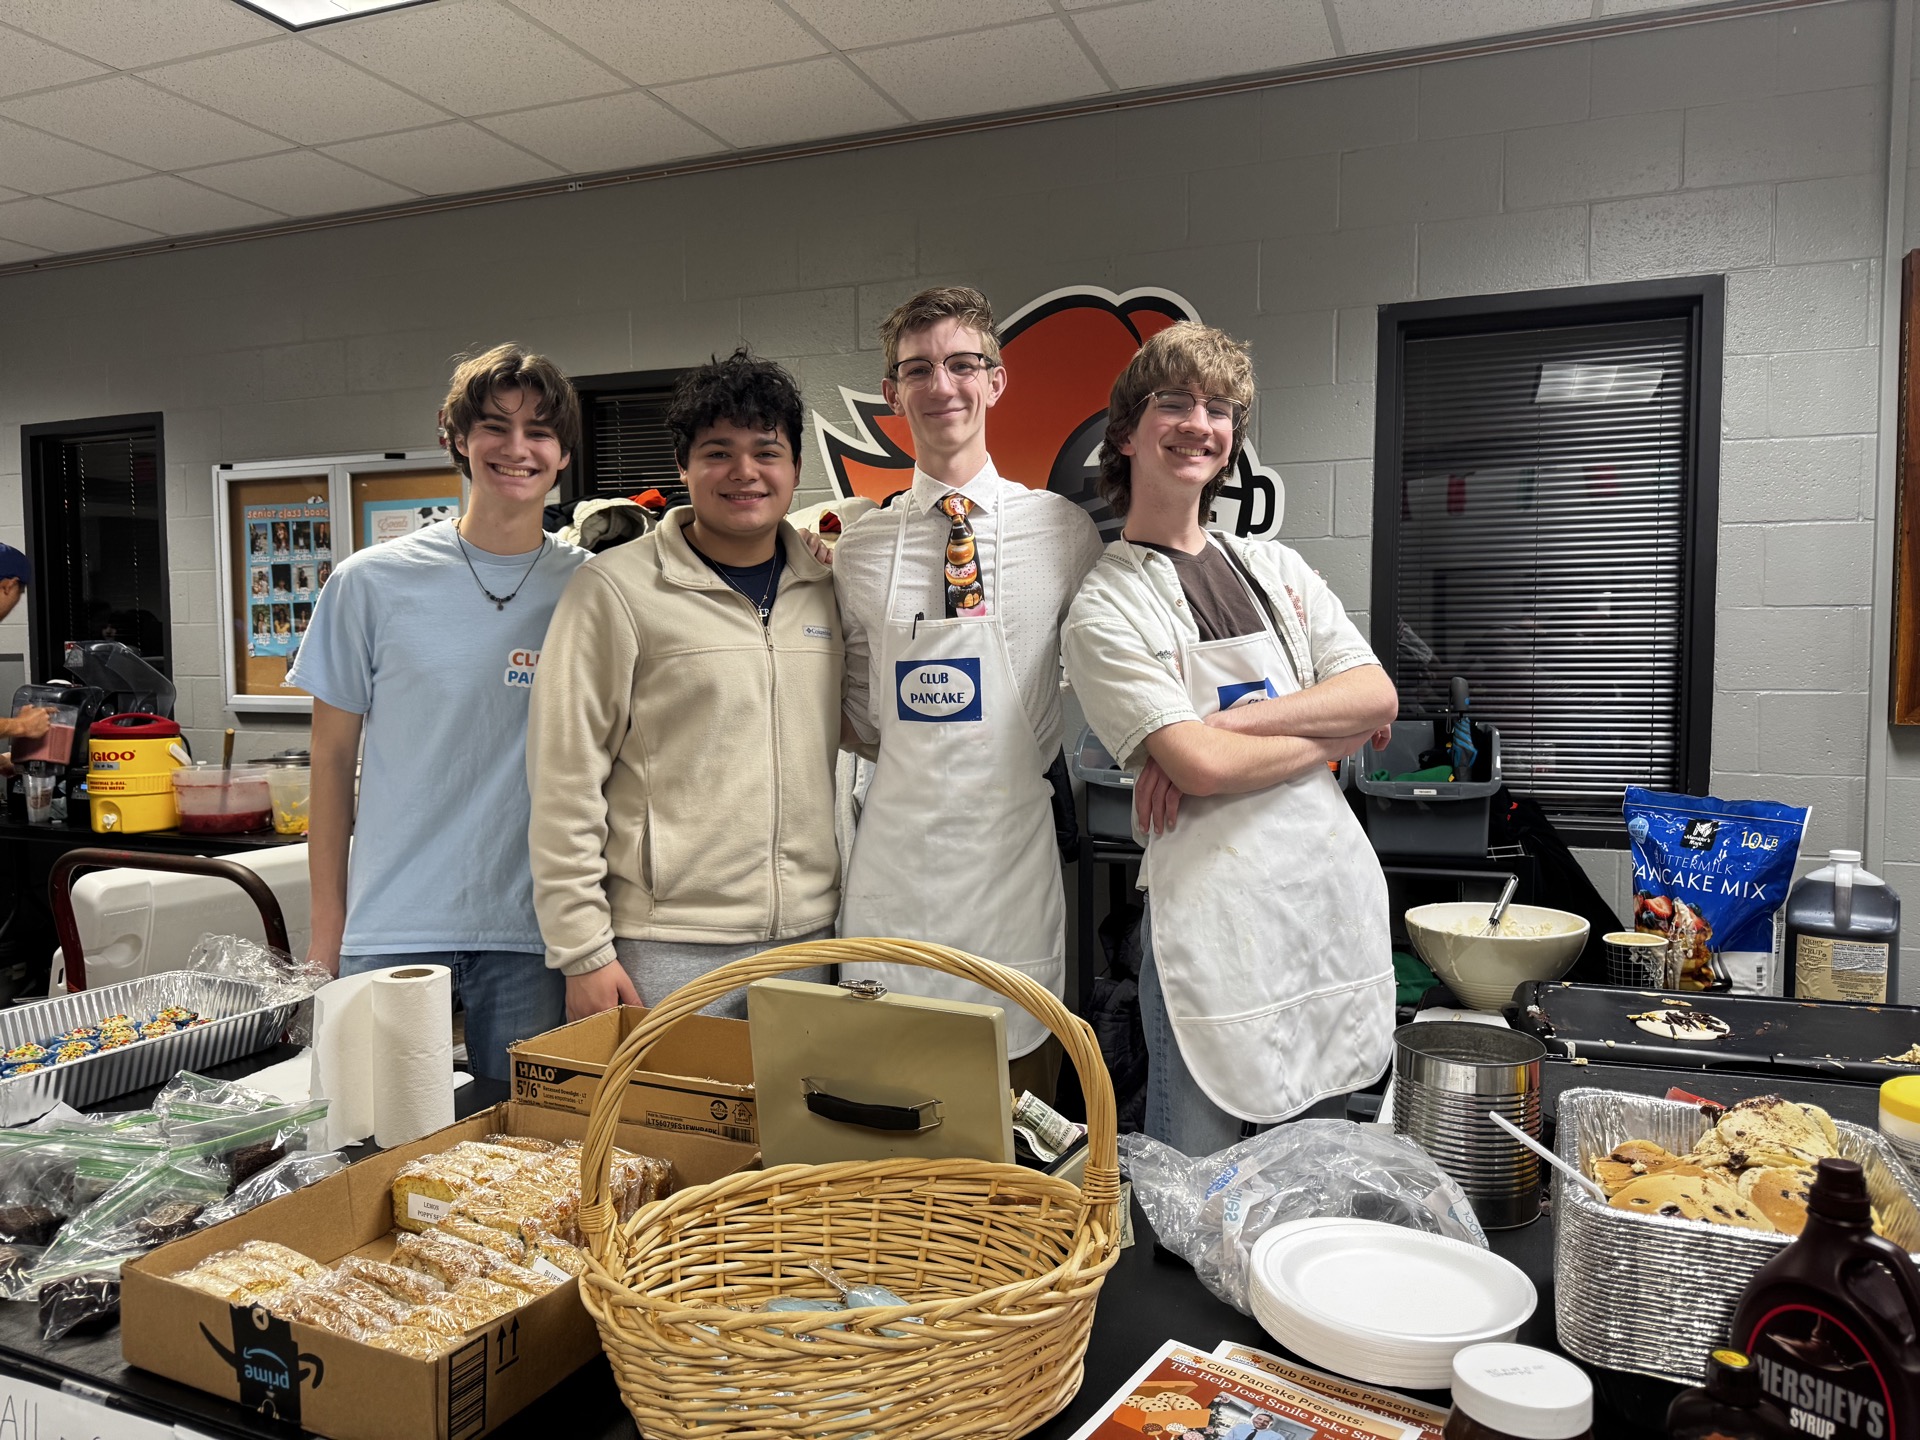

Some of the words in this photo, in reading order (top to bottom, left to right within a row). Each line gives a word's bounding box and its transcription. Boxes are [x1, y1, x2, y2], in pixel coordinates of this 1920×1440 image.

[247, 508, 276, 519] senior
[278, 508, 301, 519] class
[920, 672, 949, 684] CLUB
[910, 692, 965, 704] PANCAKE
[91, 751, 135, 761] IGLOO
[1741, 830, 1762, 849] 10
[1655, 850, 1733, 875] BUTTERMILK
[1721, 879, 1767, 900] MIX
[518, 1063, 555, 1081] HALO
[244, 1364, 290, 1389] prime
[1170, 1361, 1196, 1375] The
[1197, 1371, 1232, 1389] Help
[1232, 1384, 1265, 1401] José
[1266, 1398, 1309, 1420] Smile
[1310, 1414, 1349, 1435] Bake
[1207, 1363, 1237, 1377] Club
[1240, 1374, 1296, 1401] Pancake
[1298, 1397, 1365, 1427] Presents:
[1266, 1363, 1297, 1379] Club
[1300, 1375, 1358, 1398] Pancake
[1361, 1393, 1430, 1419] Presents:
[1756, 1352, 1884, 1439] HERSHEY'S
[1789, 1407, 1836, 1440] SYRUP
